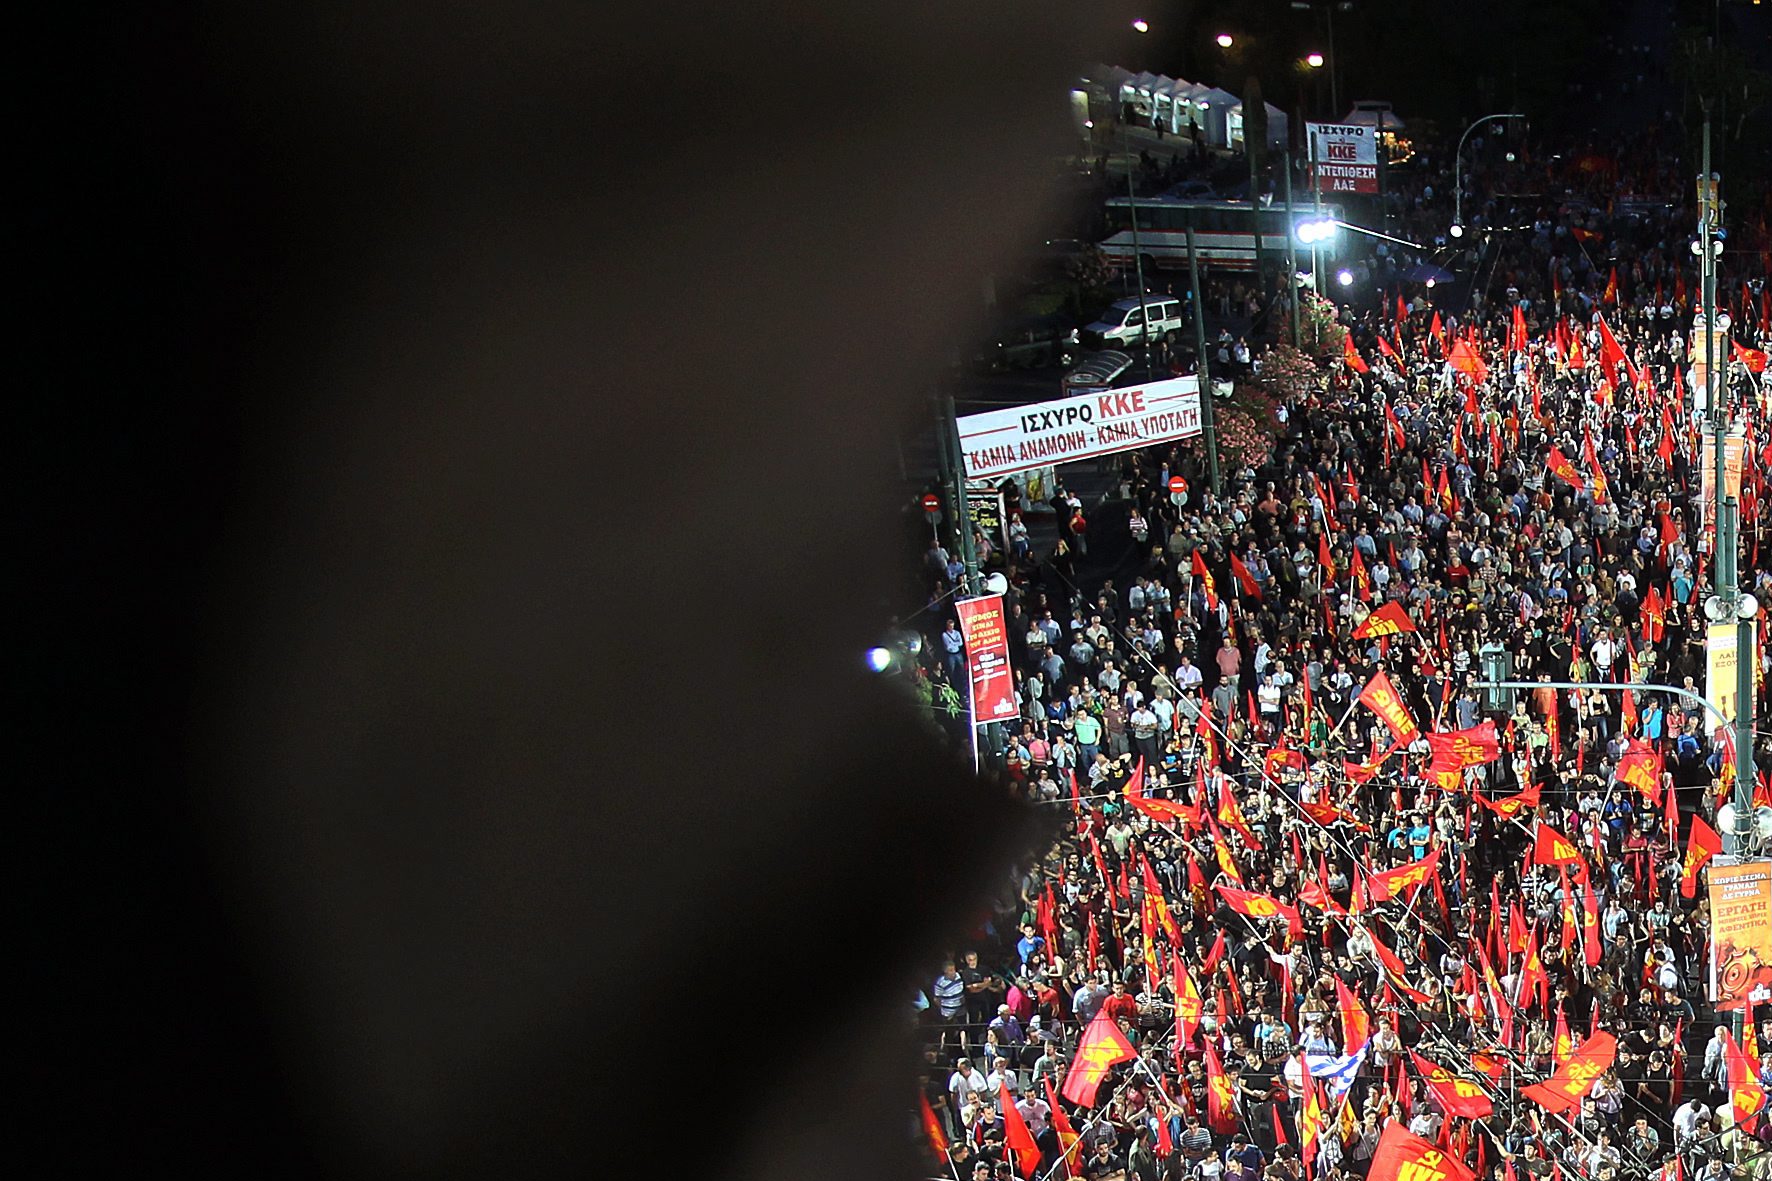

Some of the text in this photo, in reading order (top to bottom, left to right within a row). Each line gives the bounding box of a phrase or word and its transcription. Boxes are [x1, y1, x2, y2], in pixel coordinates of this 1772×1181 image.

[1318, 125, 1364, 136] ΙΣΧΥΡΟ
[1328, 144, 1357, 159] ΚΚΕ
[1311, 164, 1377, 179] ΝΤΕΠΙΘΕΣΗ
[1021, 390, 1146, 434] ΙΣΧΥΡΟ ΚΚΕ
[970, 445, 1016, 470] ΚΑΜΙΑ
[1019, 430, 1087, 461] ΑΝΑΜΟΝΗ
[1141, 407, 1199, 437] ΥΠΟΤΑΓΗ
[1384, 701, 1415, 735] ΚΝΕ
[1717, 901, 1767, 917] ΕΡΓΑΤΗ
[1719, 919, 1768, 934] ΑΦΕΝΤΙΚΑ
